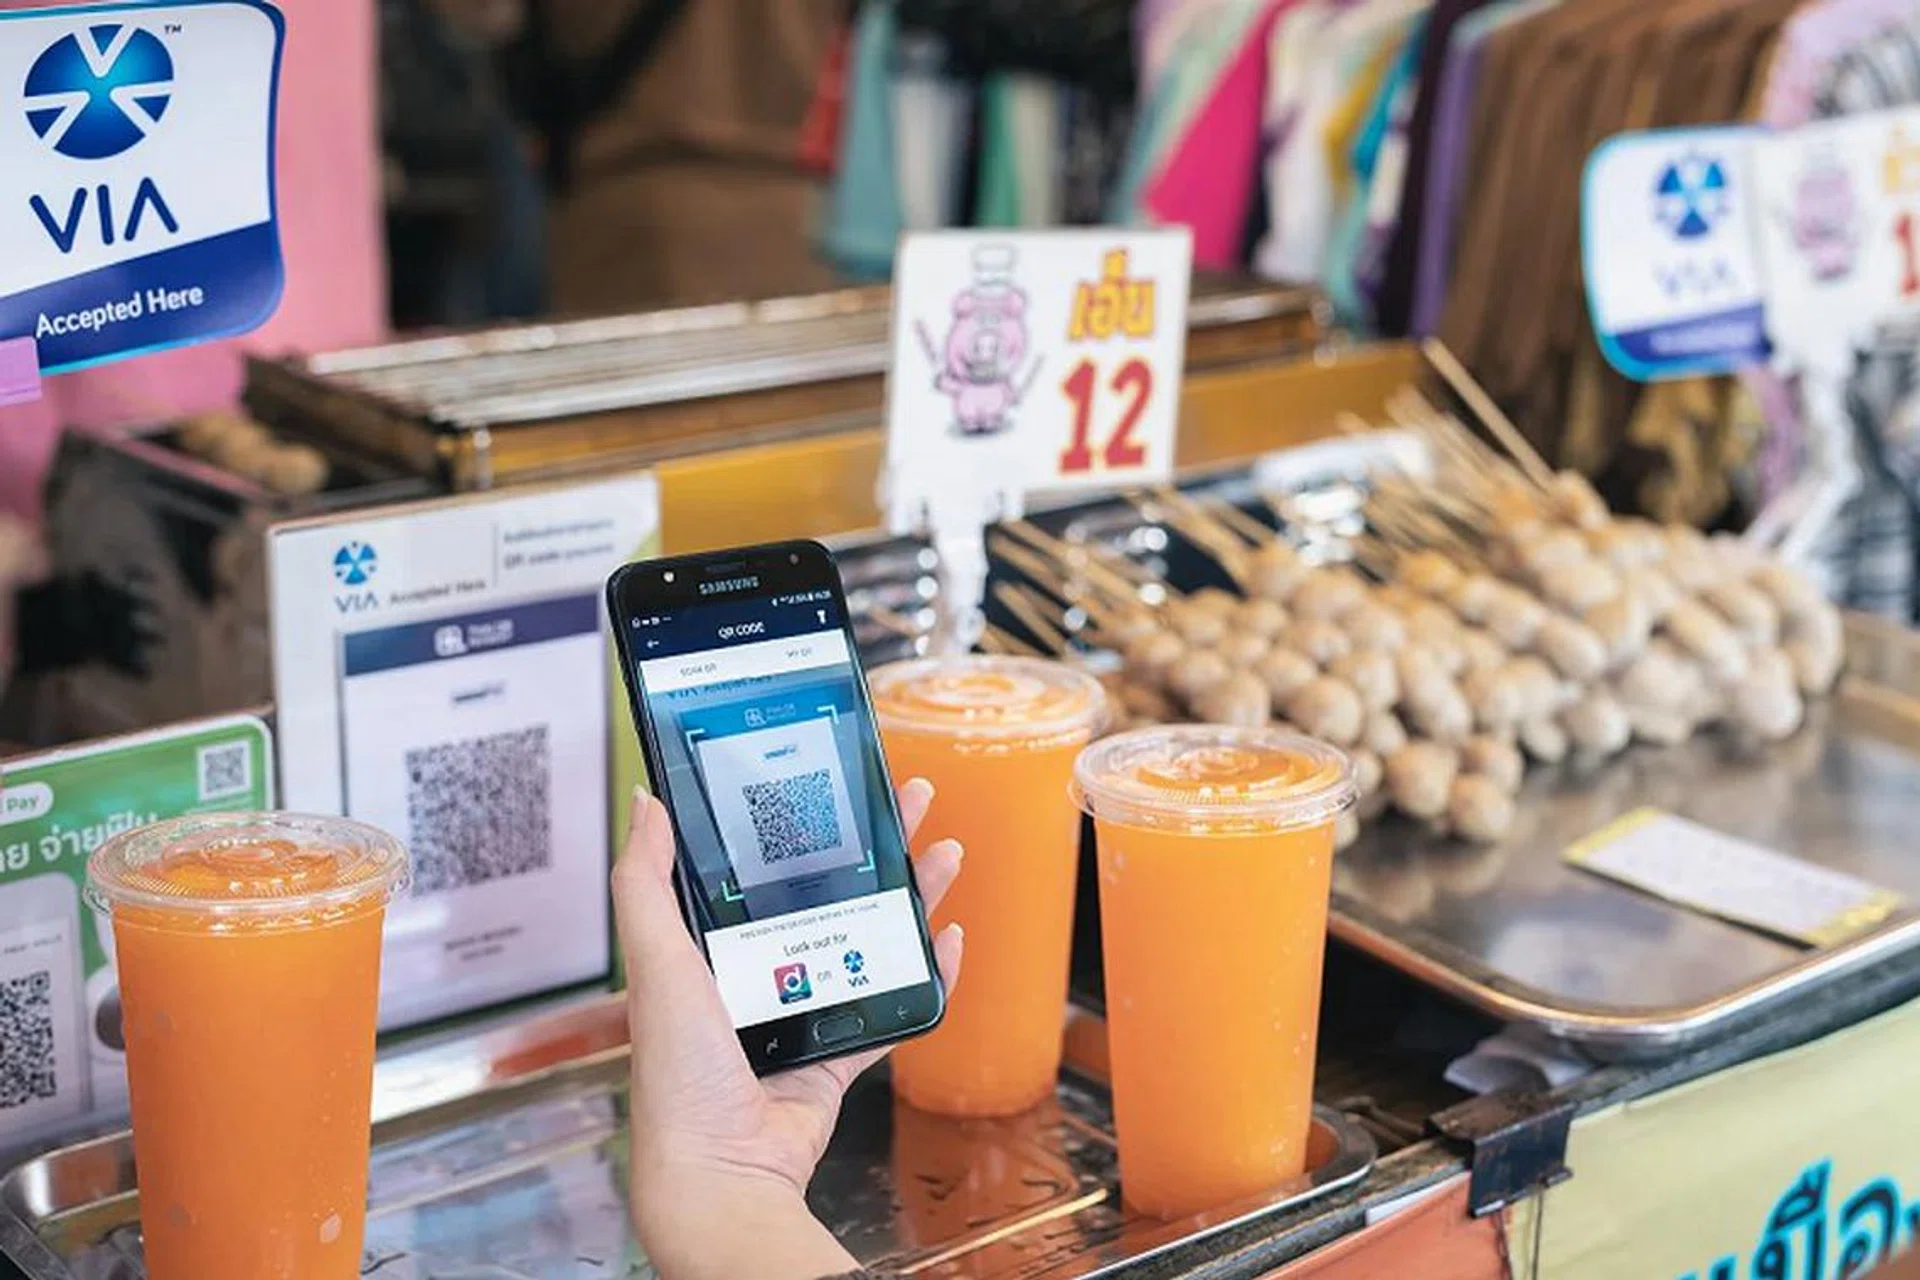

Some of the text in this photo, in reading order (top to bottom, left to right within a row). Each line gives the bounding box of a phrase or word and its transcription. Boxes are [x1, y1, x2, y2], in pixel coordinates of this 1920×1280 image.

[29, 176, 180, 254] VIA
[35, 286, 204, 339] Accepted Here
[1058, 358, 1153, 473] 12
[698, 576, 760, 595] SAMSUNG
[334, 591, 379, 613] VIA
[735, 621, 766, 637] CODE
[783, 940, 810, 957] Look
[812, 936, 831, 950] out
